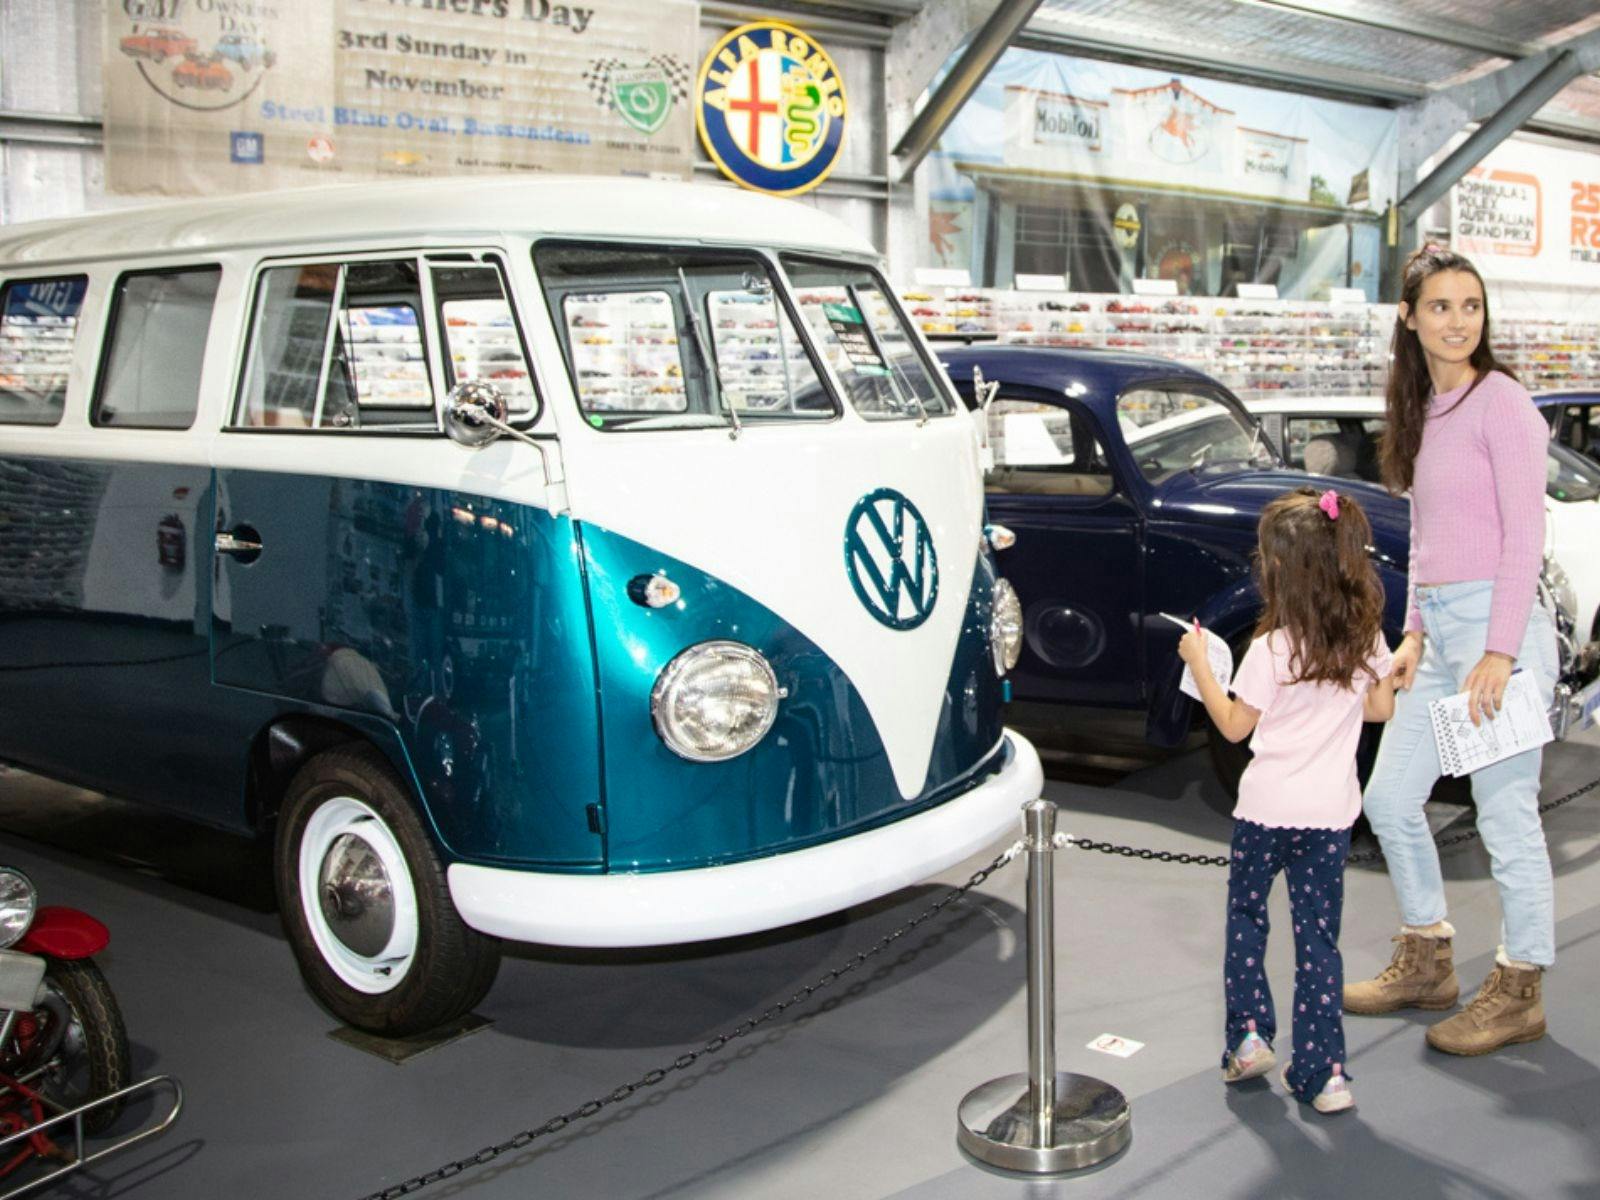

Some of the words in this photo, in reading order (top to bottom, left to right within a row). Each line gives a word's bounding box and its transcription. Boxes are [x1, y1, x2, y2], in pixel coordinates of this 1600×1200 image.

[520, 0, 596, 34] Day
[338, 29, 389, 50] 3rd
[396, 34, 497, 66] Sunday
[505, 52, 528, 65] in
[365, 68, 505, 100] November
[704, 34, 761, 113] ALFA
[260, 101, 327, 123] Steel
[334, 107, 389, 128] Blue
[1459, 222, 1501, 239] GRAND
[1504, 227, 1533, 241] PRIX
[844, 487, 939, 631] VW
